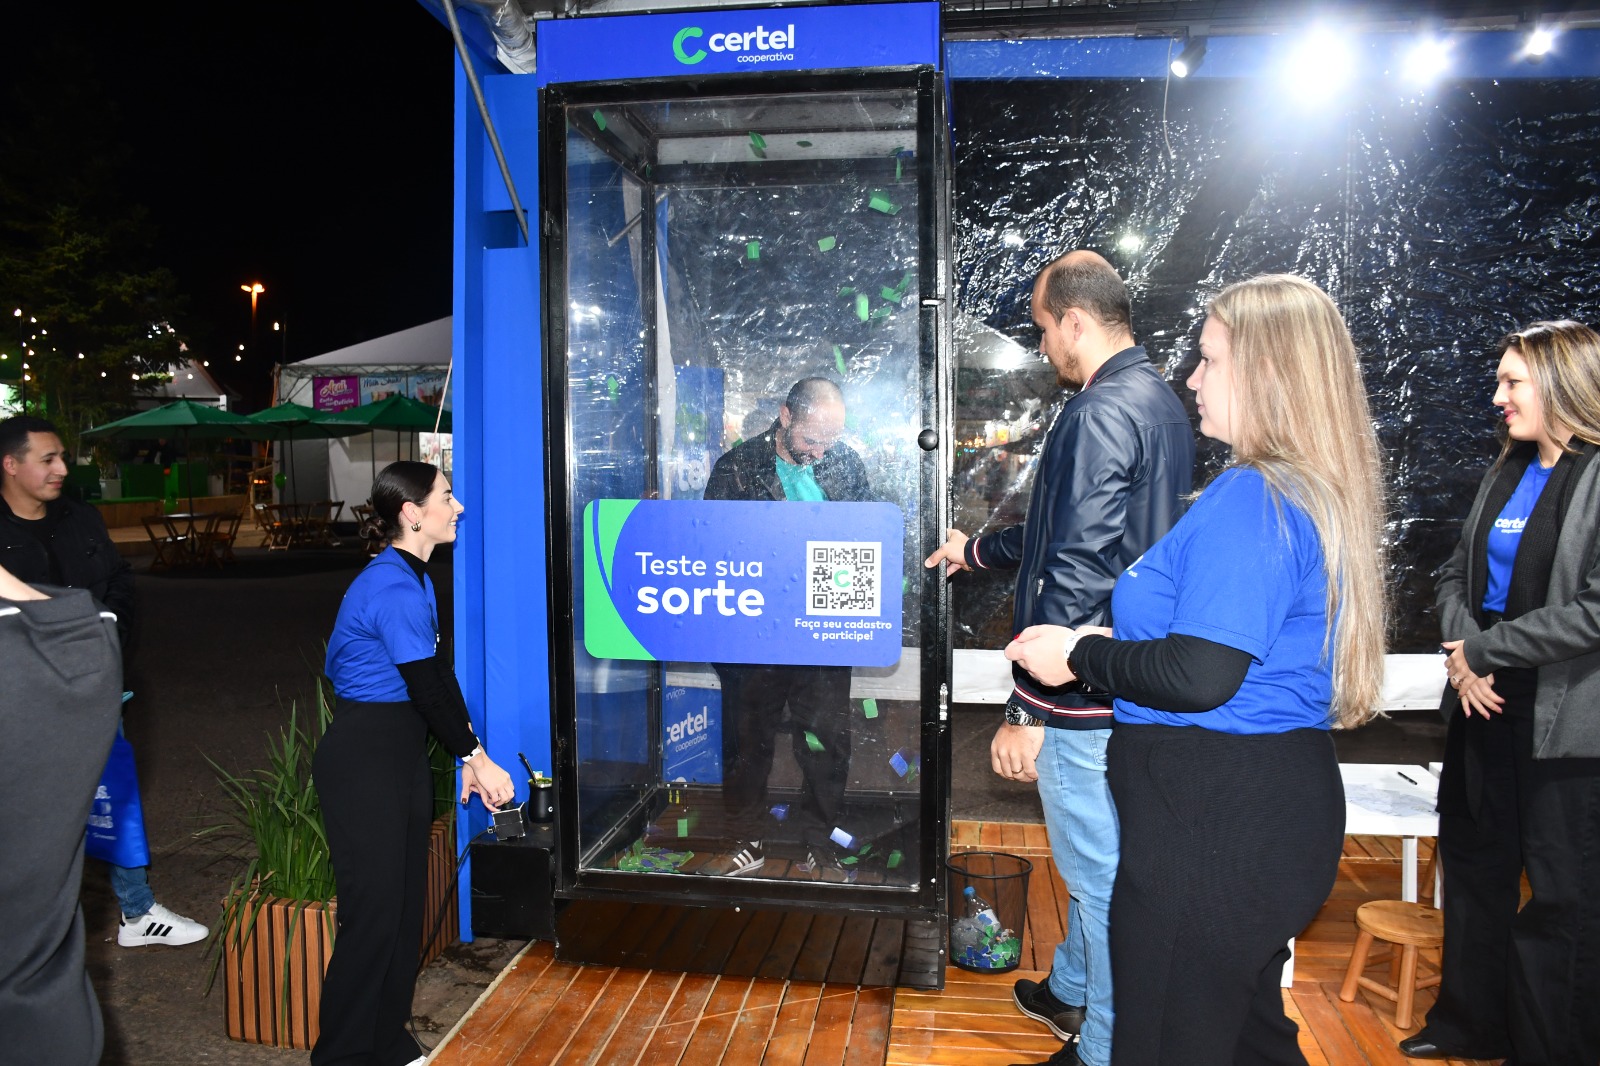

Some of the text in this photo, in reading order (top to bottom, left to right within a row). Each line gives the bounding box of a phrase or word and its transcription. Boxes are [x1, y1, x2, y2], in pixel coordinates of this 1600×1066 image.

[708, 23, 795, 53] certel
[736, 51, 794, 64] cooperativa
[634, 551, 763, 578] Teste sua
[636, 579, 765, 617] sorte
[794, 618, 893, 630] Faça seu cadastro
[821, 631, 873, 642] participe!
[675, 733, 708, 753] cooperativa
